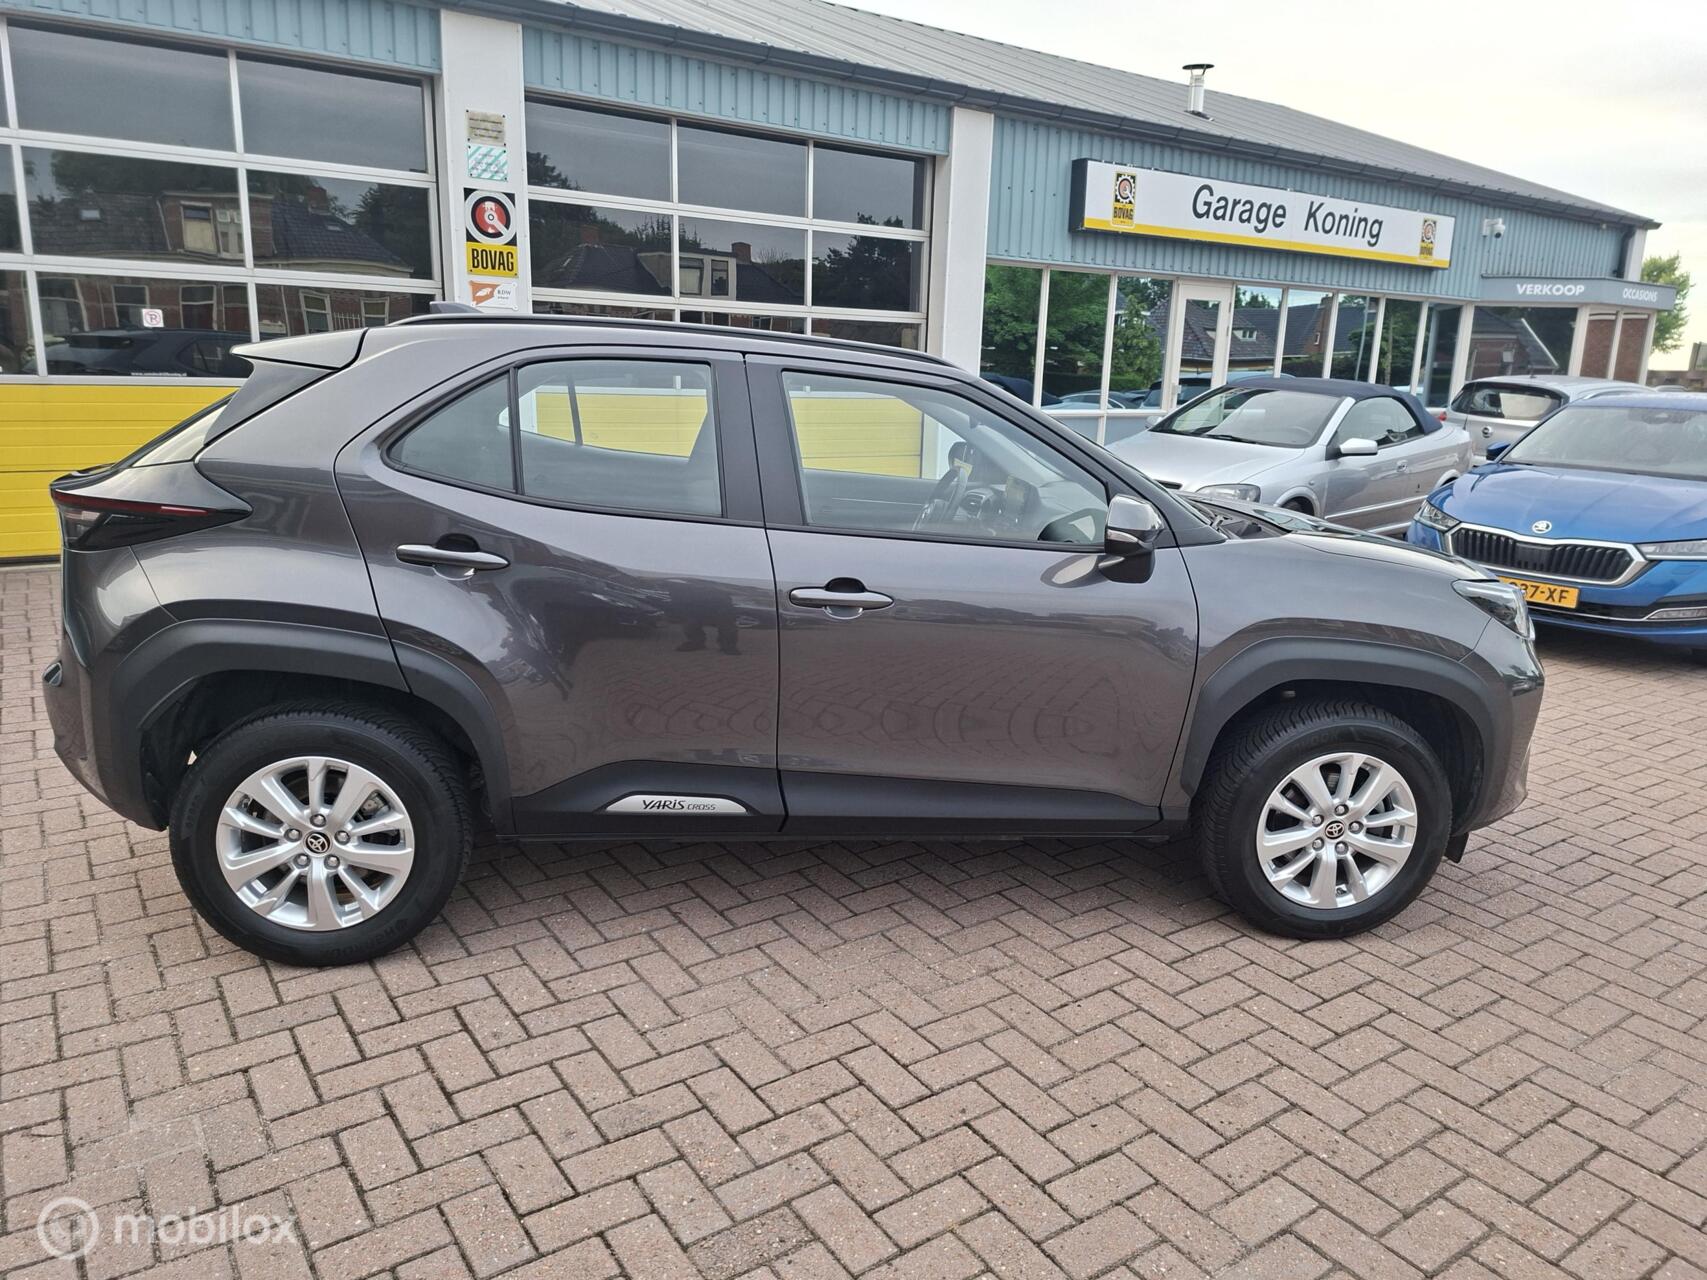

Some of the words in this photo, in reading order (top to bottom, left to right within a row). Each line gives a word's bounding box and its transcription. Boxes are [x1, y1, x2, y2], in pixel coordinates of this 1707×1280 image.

[1113, 206, 1134, 221] BOVAG
[1192, 184, 1287, 234] Garage
[1304, 201, 1384, 248] Koning
[471, 248, 515, 272] BOVAG
[1516, 283, 1585, 296] VERKOOP
[1622, 287, 1658, 302] OCCASIONS
[1509, 581, 1569, 603] 37-XF
[687, 803, 716, 811] CROSS
